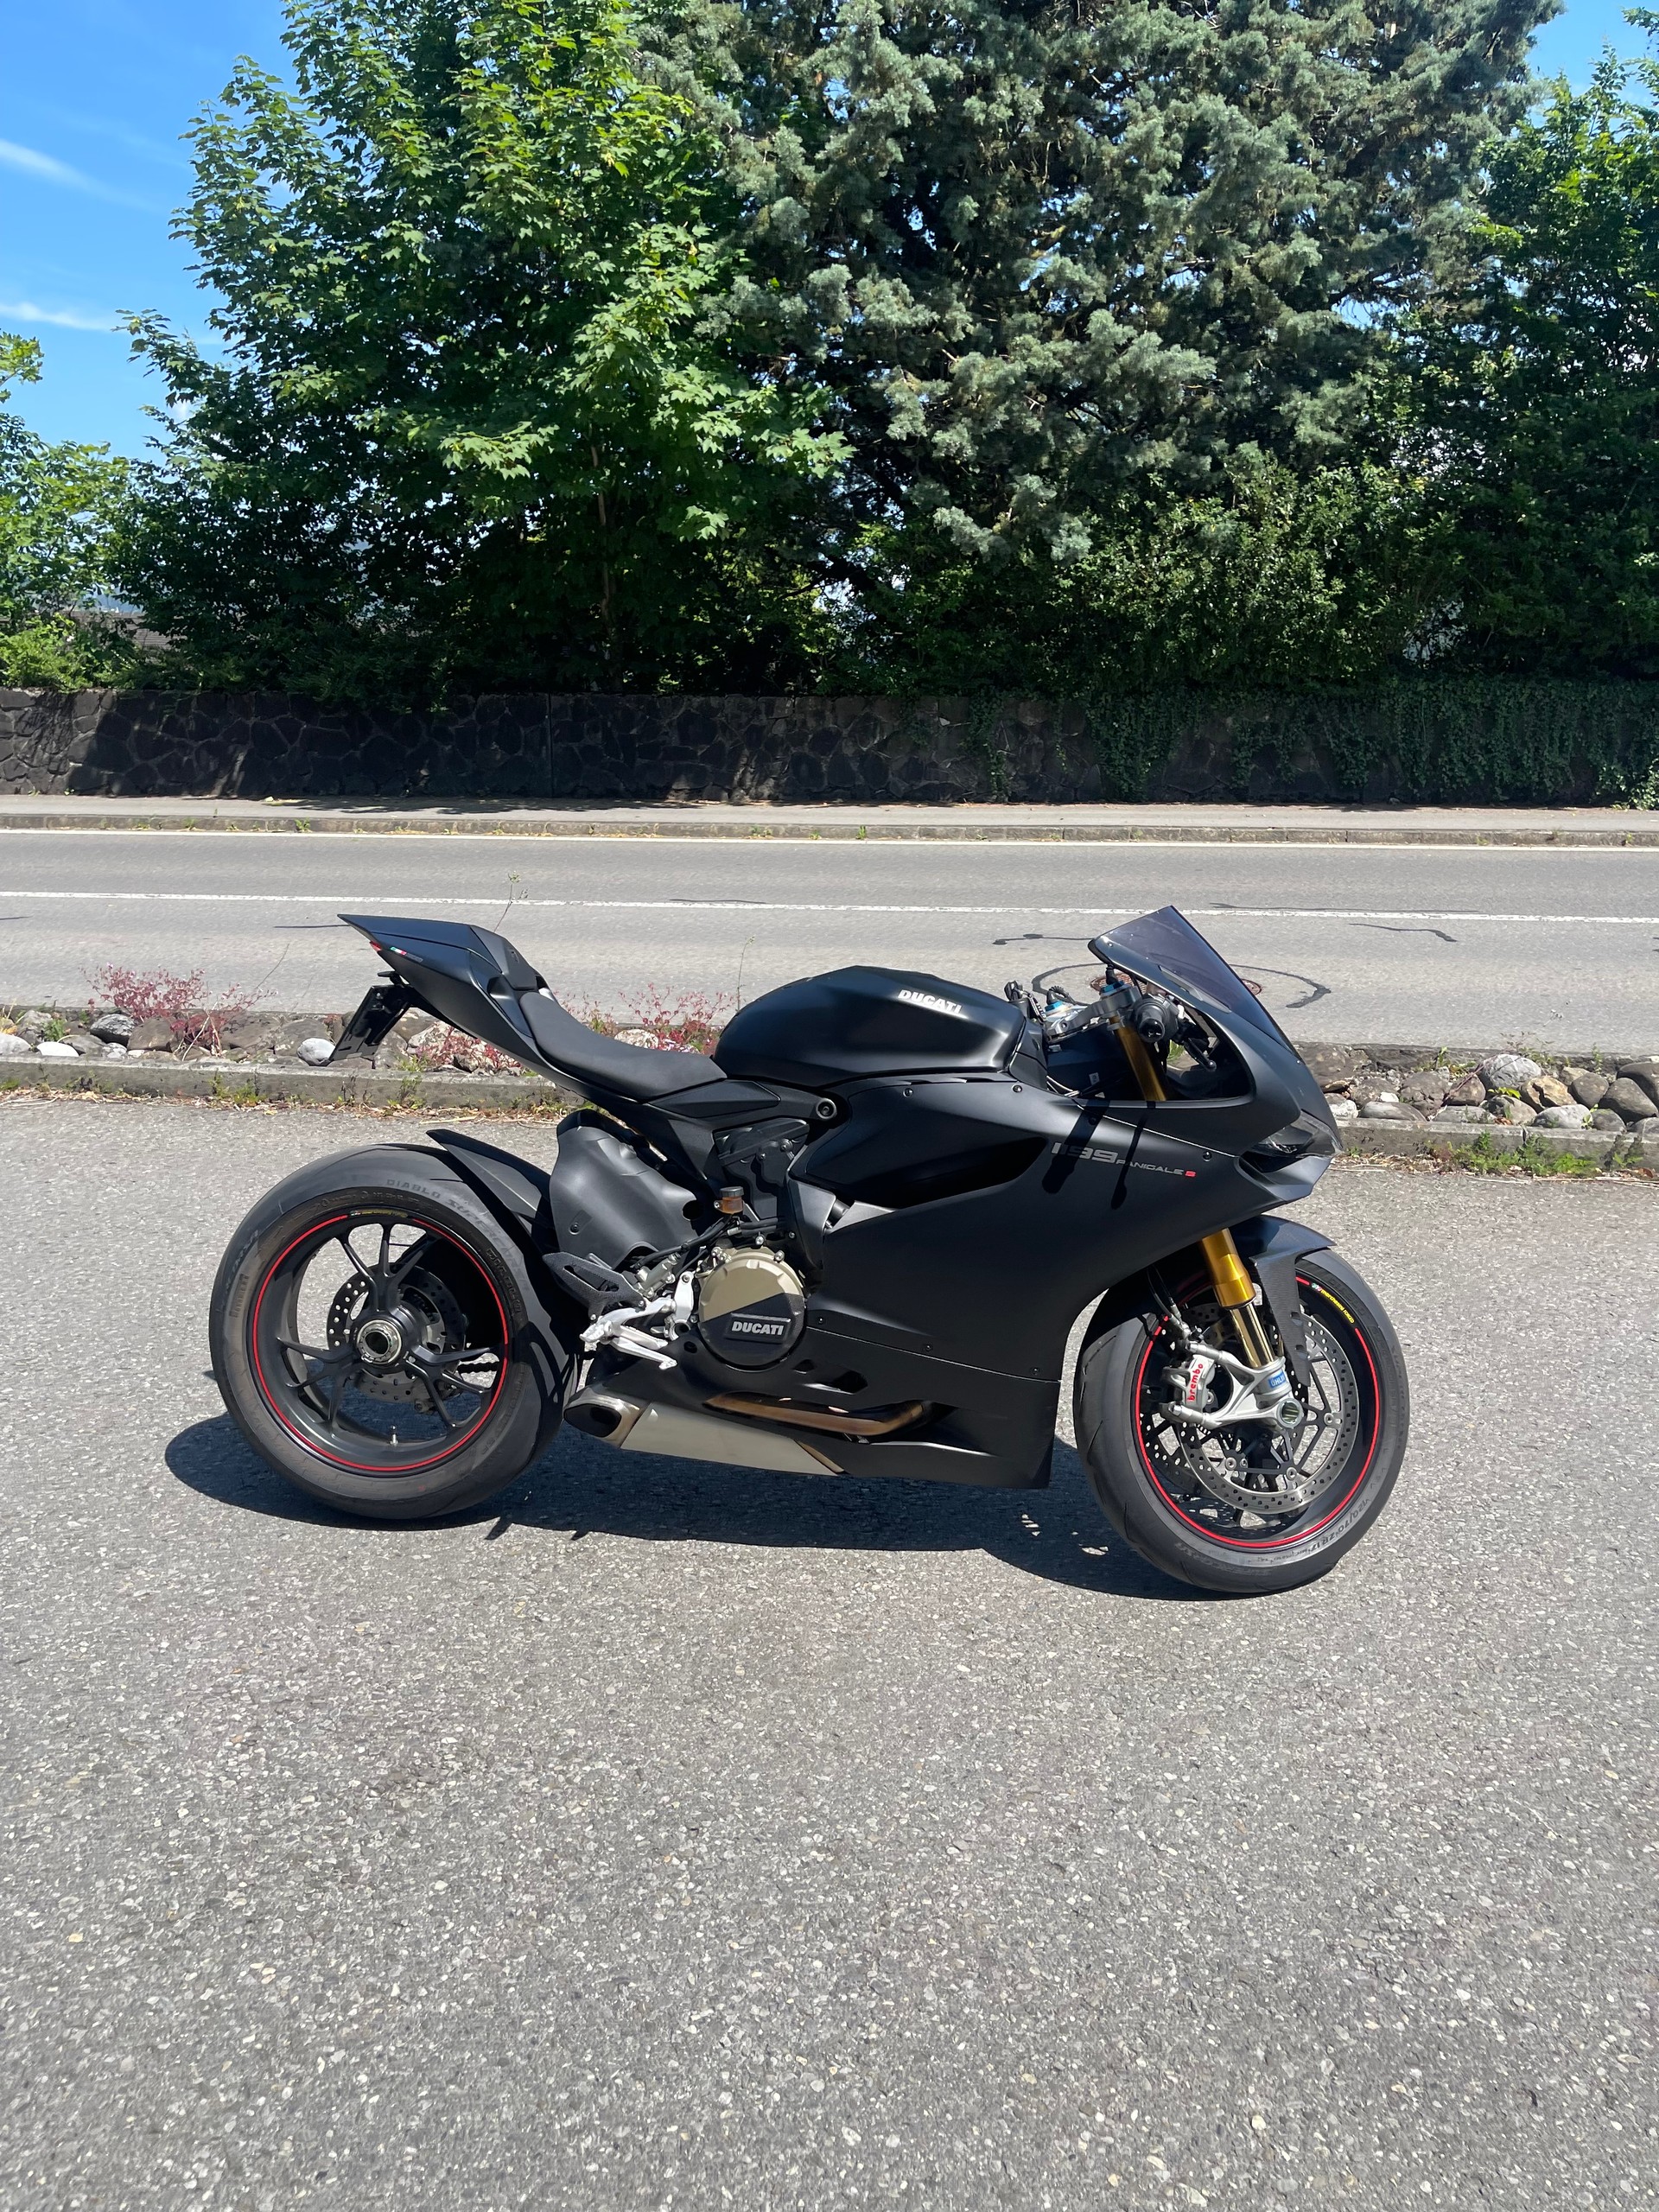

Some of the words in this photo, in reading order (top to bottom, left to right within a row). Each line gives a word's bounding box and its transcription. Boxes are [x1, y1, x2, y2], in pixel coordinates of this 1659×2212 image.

[898, 989, 963, 1014] DUCATI
[1116, 1159, 1184, 1175] PANIGALE
[386, 1179, 441, 1199] DIABLO
[731, 1321, 785, 1336] DUCATI
[1186, 1363, 1204, 1402] brembo
[1338, 1499, 1369, 1533] 120/70
